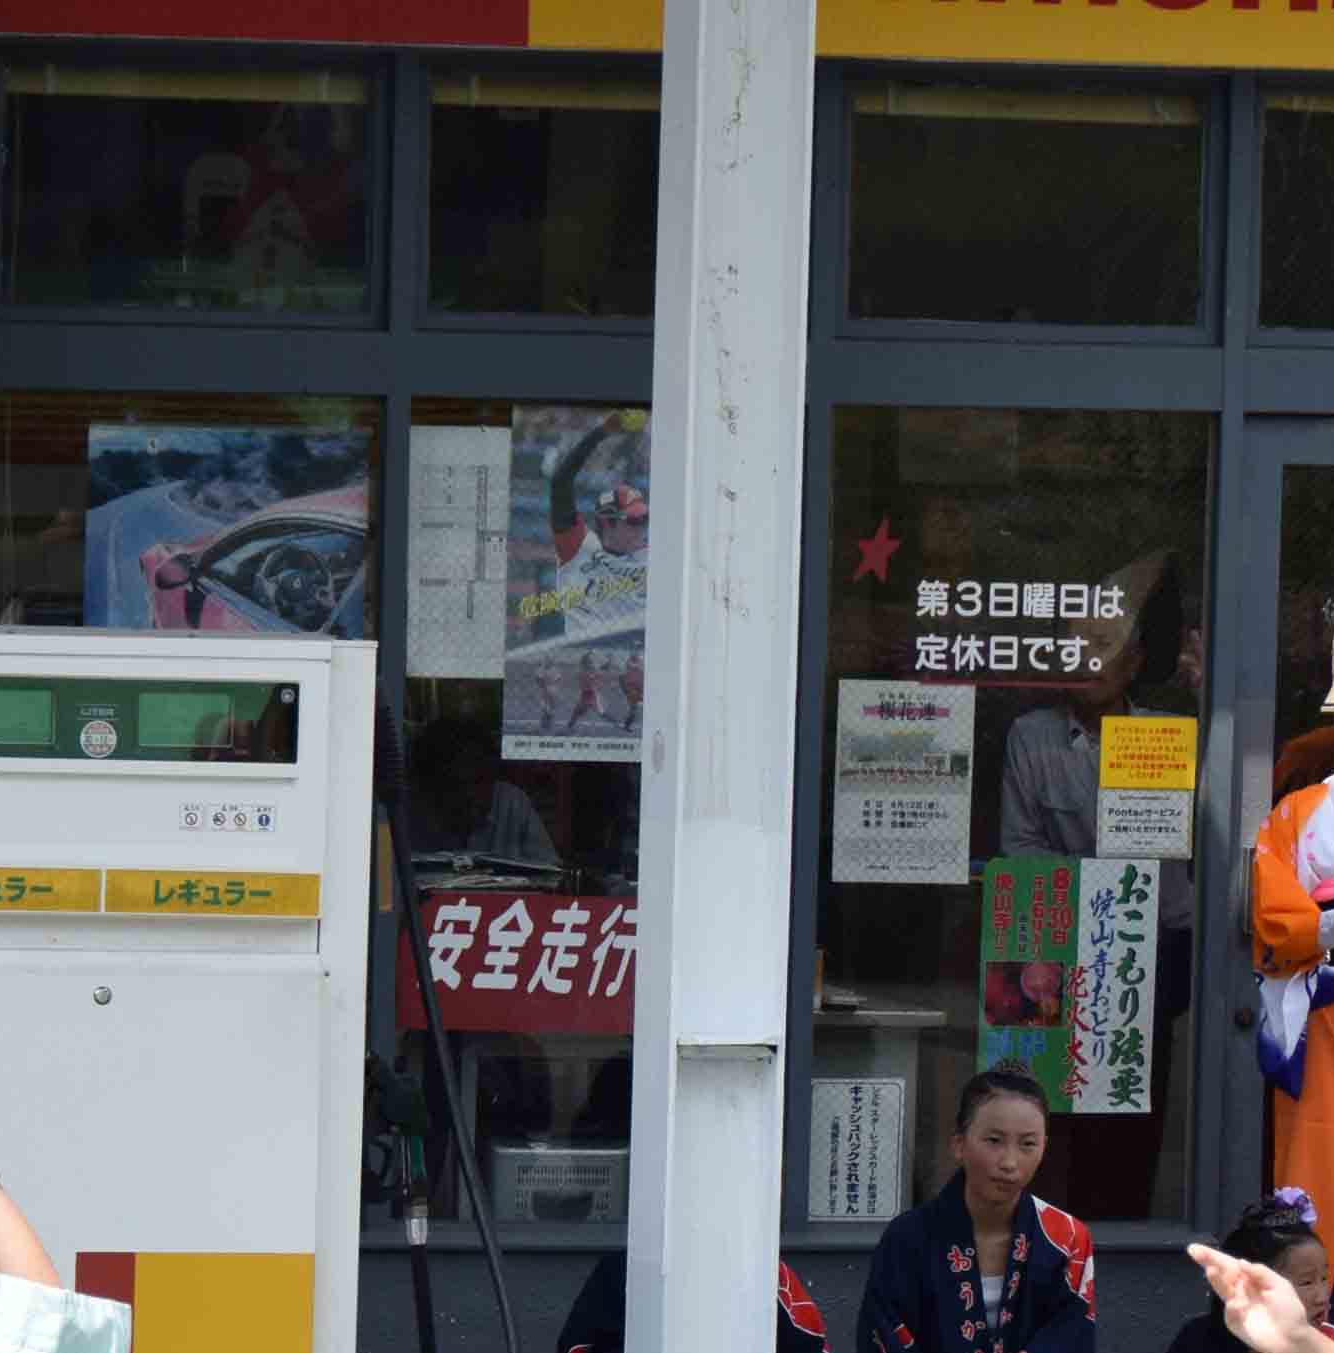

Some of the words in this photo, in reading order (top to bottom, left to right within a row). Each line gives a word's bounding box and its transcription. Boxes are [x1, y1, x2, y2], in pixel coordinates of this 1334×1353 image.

[916, 580, 1125, 619] 第3日曜日は
[915, 635, 1102, 672] 定休日です。
[153, 877, 274, 906] レギュラー
[423, 898, 639, 998] 安全走行
[1088, 887, 1116, 1067] 焼山寺おどり
[1107, 864, 1153, 1108] おこもり法要
[1060, 965, 1090, 1100] 花火大会
